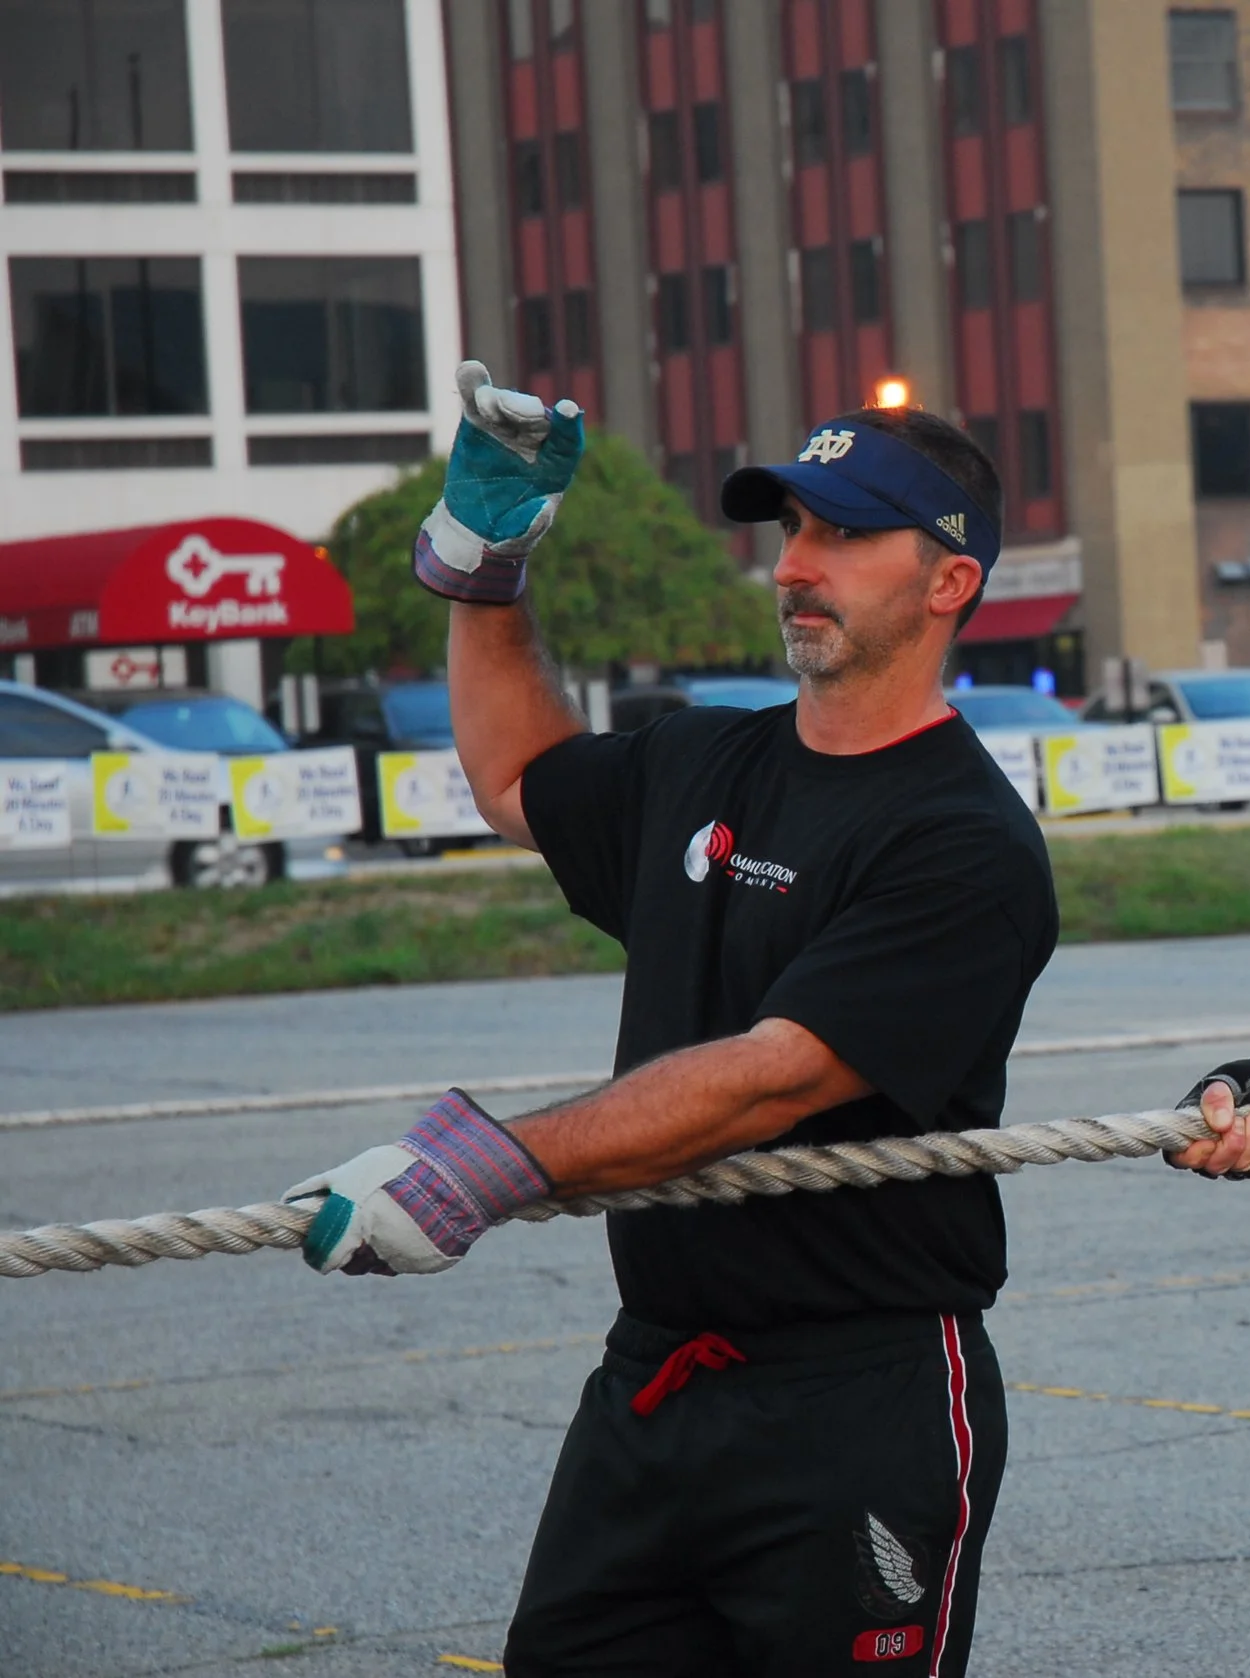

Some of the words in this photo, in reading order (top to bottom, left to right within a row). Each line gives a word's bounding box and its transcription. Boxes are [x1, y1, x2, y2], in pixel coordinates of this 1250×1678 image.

[936, 517, 967, 546] adidas
[168, 600, 288, 634] KeyBank
[875, 1632, 906, 1657] 09
